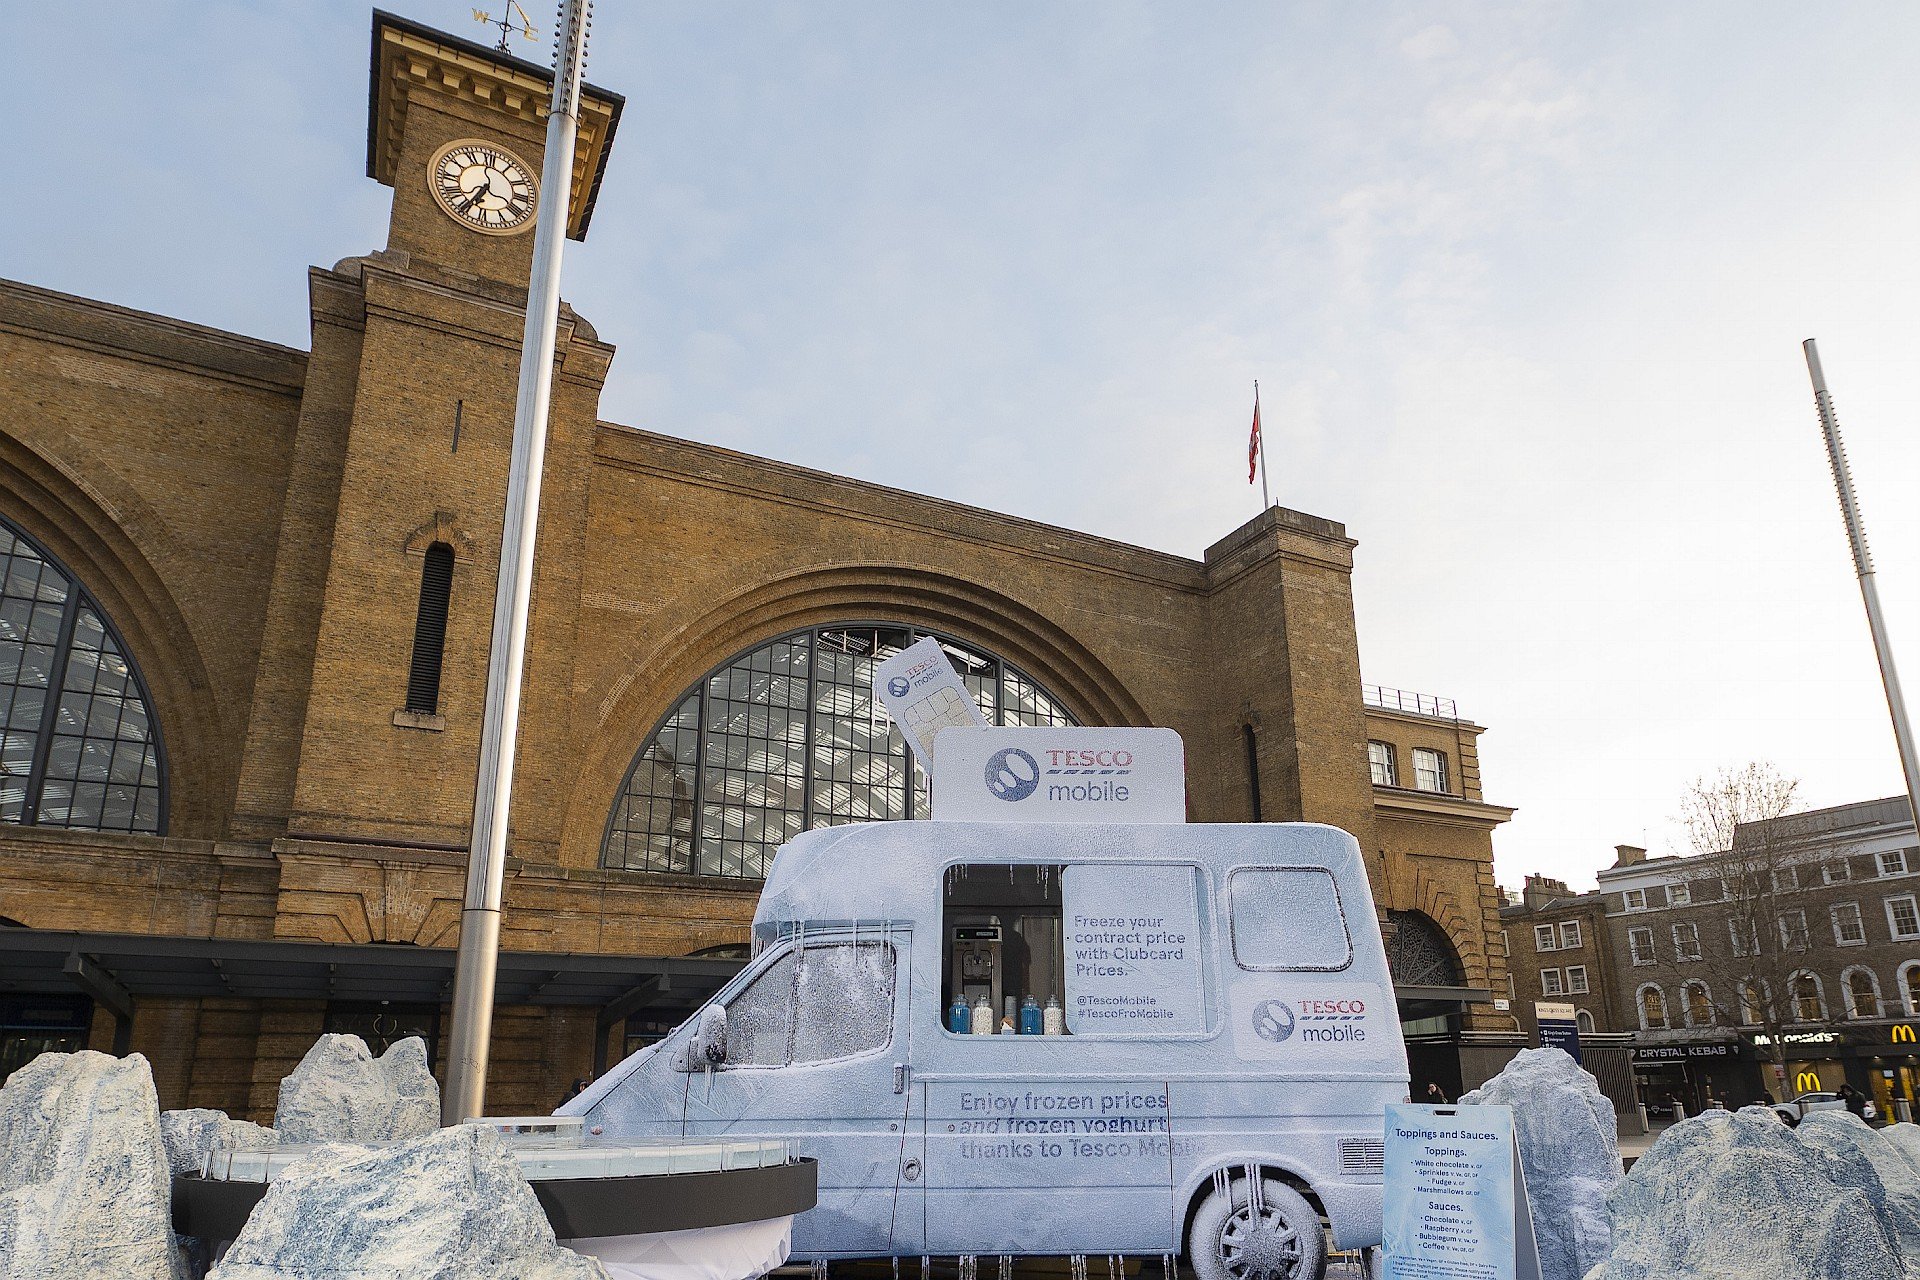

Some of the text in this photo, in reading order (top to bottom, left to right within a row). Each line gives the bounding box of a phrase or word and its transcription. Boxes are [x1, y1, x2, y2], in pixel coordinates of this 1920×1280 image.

[906, 656, 937, 676] TESCO
[914, 667, 944, 688] mobile
[1046, 750, 1133, 766] TESCO
[1049, 781, 1130, 801] mobile
[1074, 915, 1164, 930] Freeze your
[1074, 932, 1186, 946] contract price
[1076, 947, 1184, 960] with Clubcard
[1076, 963, 1128, 976] Prices.
[1076, 996, 1157, 1006] @TescoMobile
[1298, 1000, 1365, 1014] TESCO
[1078, 1008, 1174, 1019] #TescoFroMobile
[1303, 1024, 1366, 1042] mobile
[1640, 1046, 1726, 1058] CRYSTAL KEBAB
[960, 1091, 1168, 1114] Enjoy frozen prices
[960, 1118, 1000, 1134] and
[1006, 1117, 1076, 1134] frozen
[1396, 1128, 1498, 1140] Toppings and Sauces.
[960, 1140, 1033, 1158] thanks
[1040, 1141, 1062, 1158] to
[1069, 1138, 1131, 1158] Tesco
[1424, 1146, 1467, 1157] Toppings.
[1436, 1160, 1469, 1168] chocolate
[1432, 1178, 1452, 1186] Fudge
[1417, 1186, 1464, 1195] Marshmallows
[1428, 1201, 1464, 1212] Sauces.
[1424, 1215, 1460, 1224] Chocolate
[1424, 1224, 1460, 1234] Raspberry
[1419, 1233, 1456, 1242] Bubblegum
[1422, 1242, 1445, 1250] Coffee
